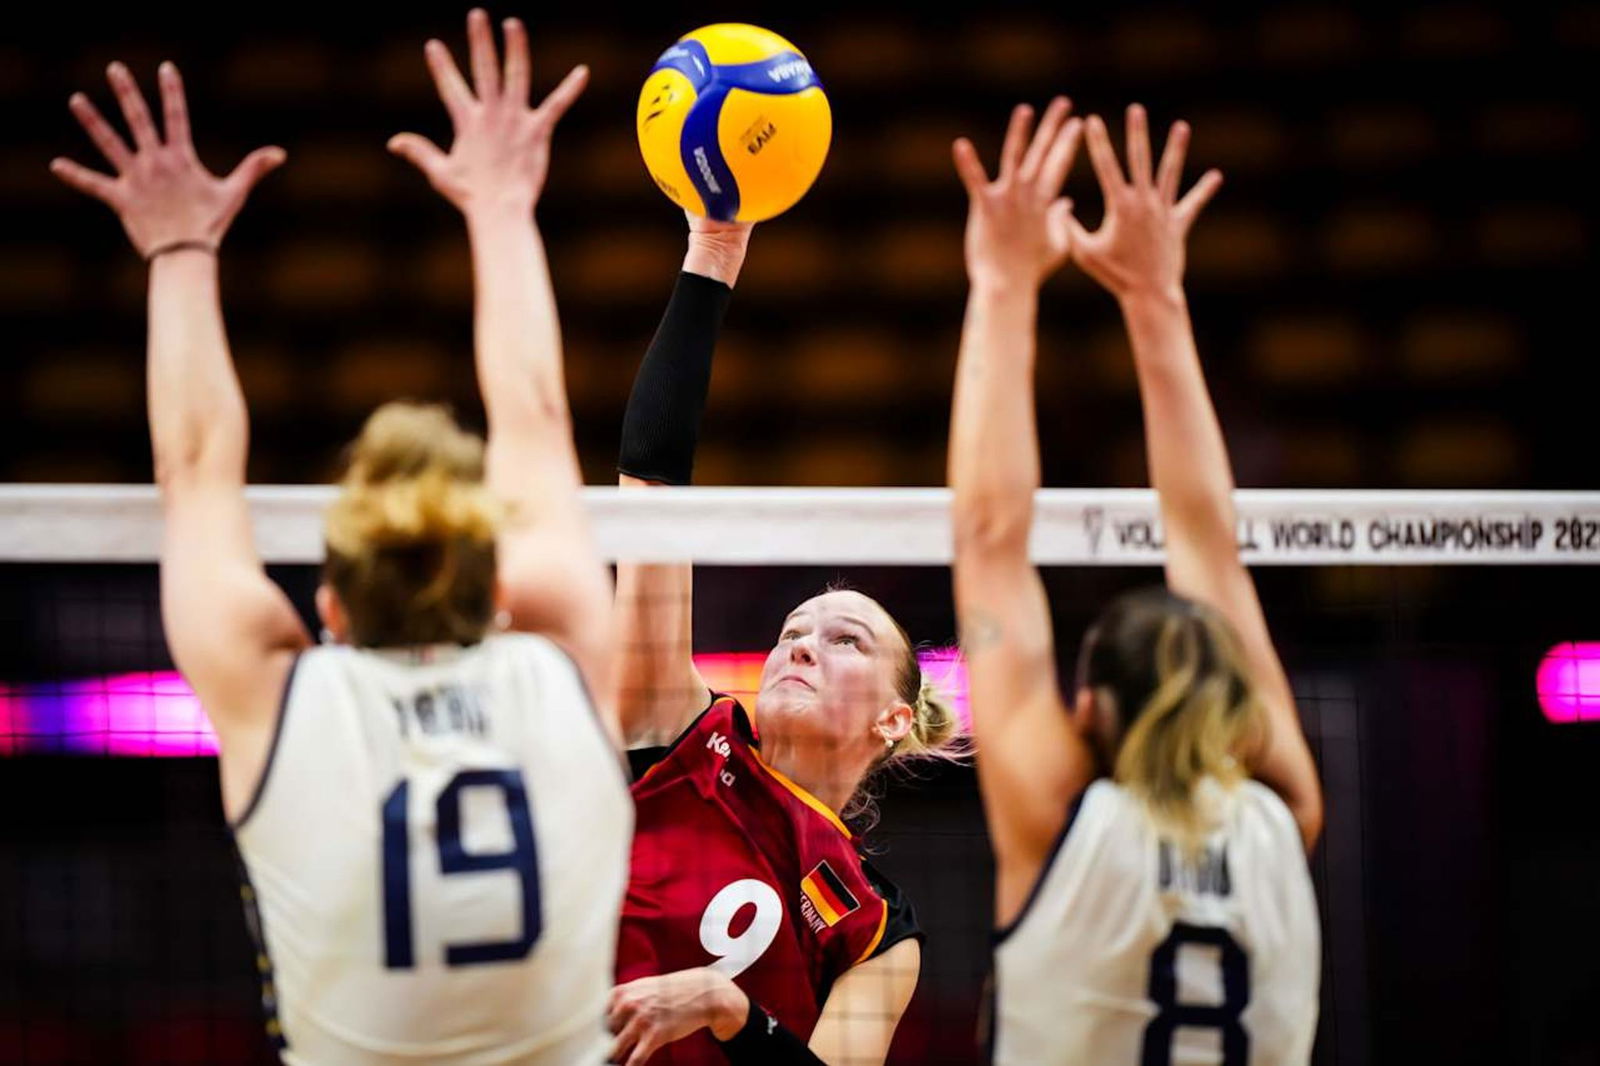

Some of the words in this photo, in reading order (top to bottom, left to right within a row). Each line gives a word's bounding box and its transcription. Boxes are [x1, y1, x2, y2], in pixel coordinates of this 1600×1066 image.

[1272, 519, 1355, 550] WORLD
[1369, 517, 1543, 550] CHAMPIONSHIP
[381, 767, 543, 969] 19
[800, 890, 827, 934] ERMANY
[699, 878, 783, 981] 9
[1141, 920, 1252, 1066] 8
